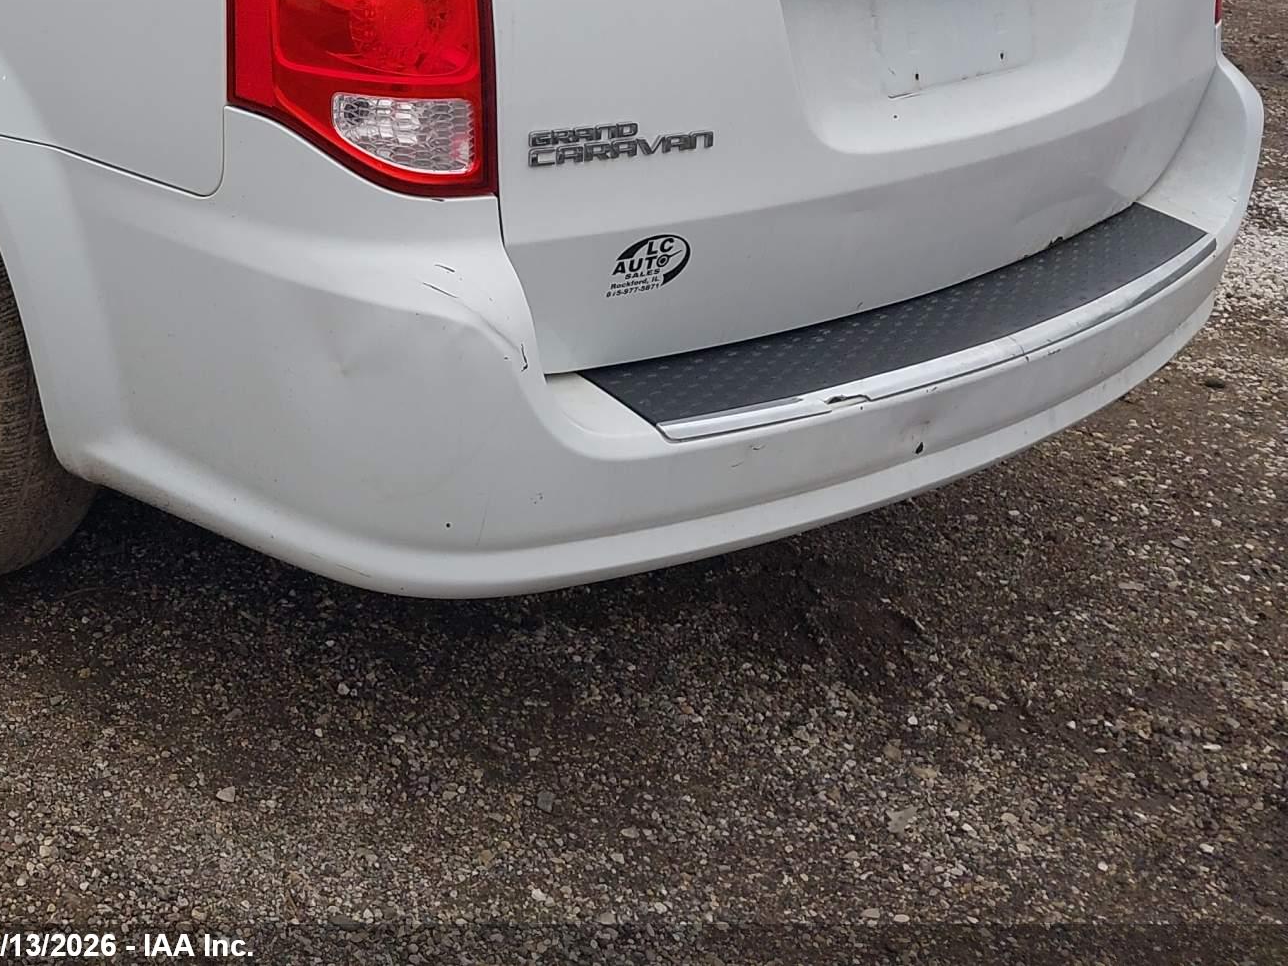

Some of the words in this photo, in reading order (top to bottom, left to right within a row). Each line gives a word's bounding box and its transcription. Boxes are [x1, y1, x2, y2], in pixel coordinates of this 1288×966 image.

[528, 121, 639, 147] GRAND
[528, 130, 714, 168] CARAVAN
[647, 237, 675, 255] LC
[612, 254, 670, 275] AUTO
[624, 268, 661, 280] SALES
[610, 278, 649, 290] Rockford,
[651, 275, 660, 283] IL
